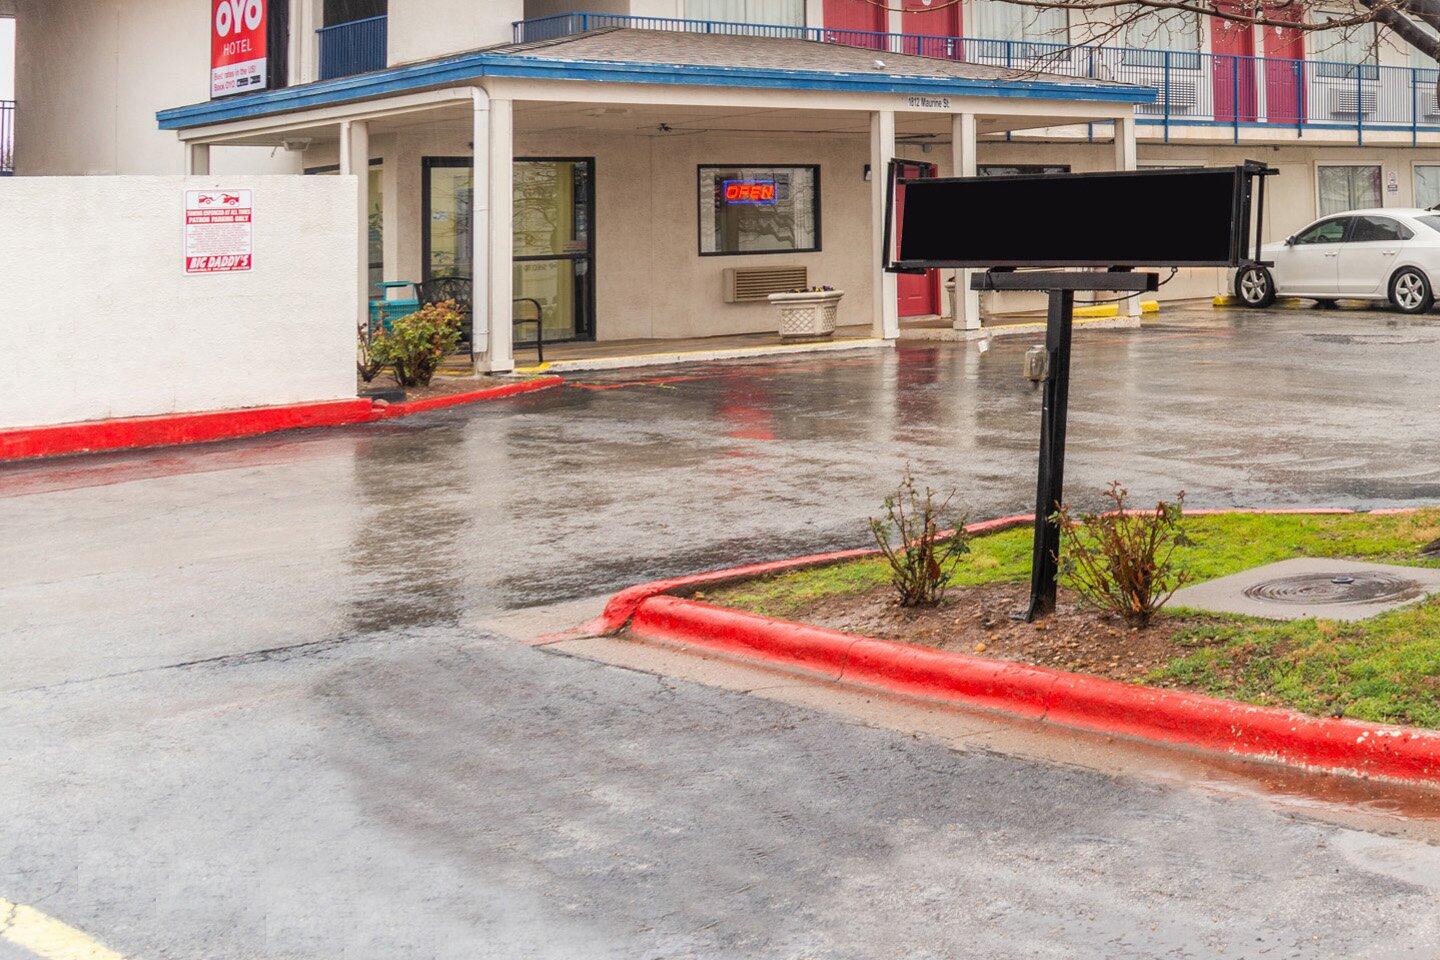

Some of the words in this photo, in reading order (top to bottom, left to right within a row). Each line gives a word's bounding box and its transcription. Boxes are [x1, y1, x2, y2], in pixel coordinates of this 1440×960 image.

[223, 38, 253, 56] HOTEL
[908, 96, 920, 107] 1812
[726, 184, 774, 200] OPEN
[211, 215, 234, 223] PARKING
[189, 257, 208, 269] BIG
[207, 255, 248, 267] DADDY'S
